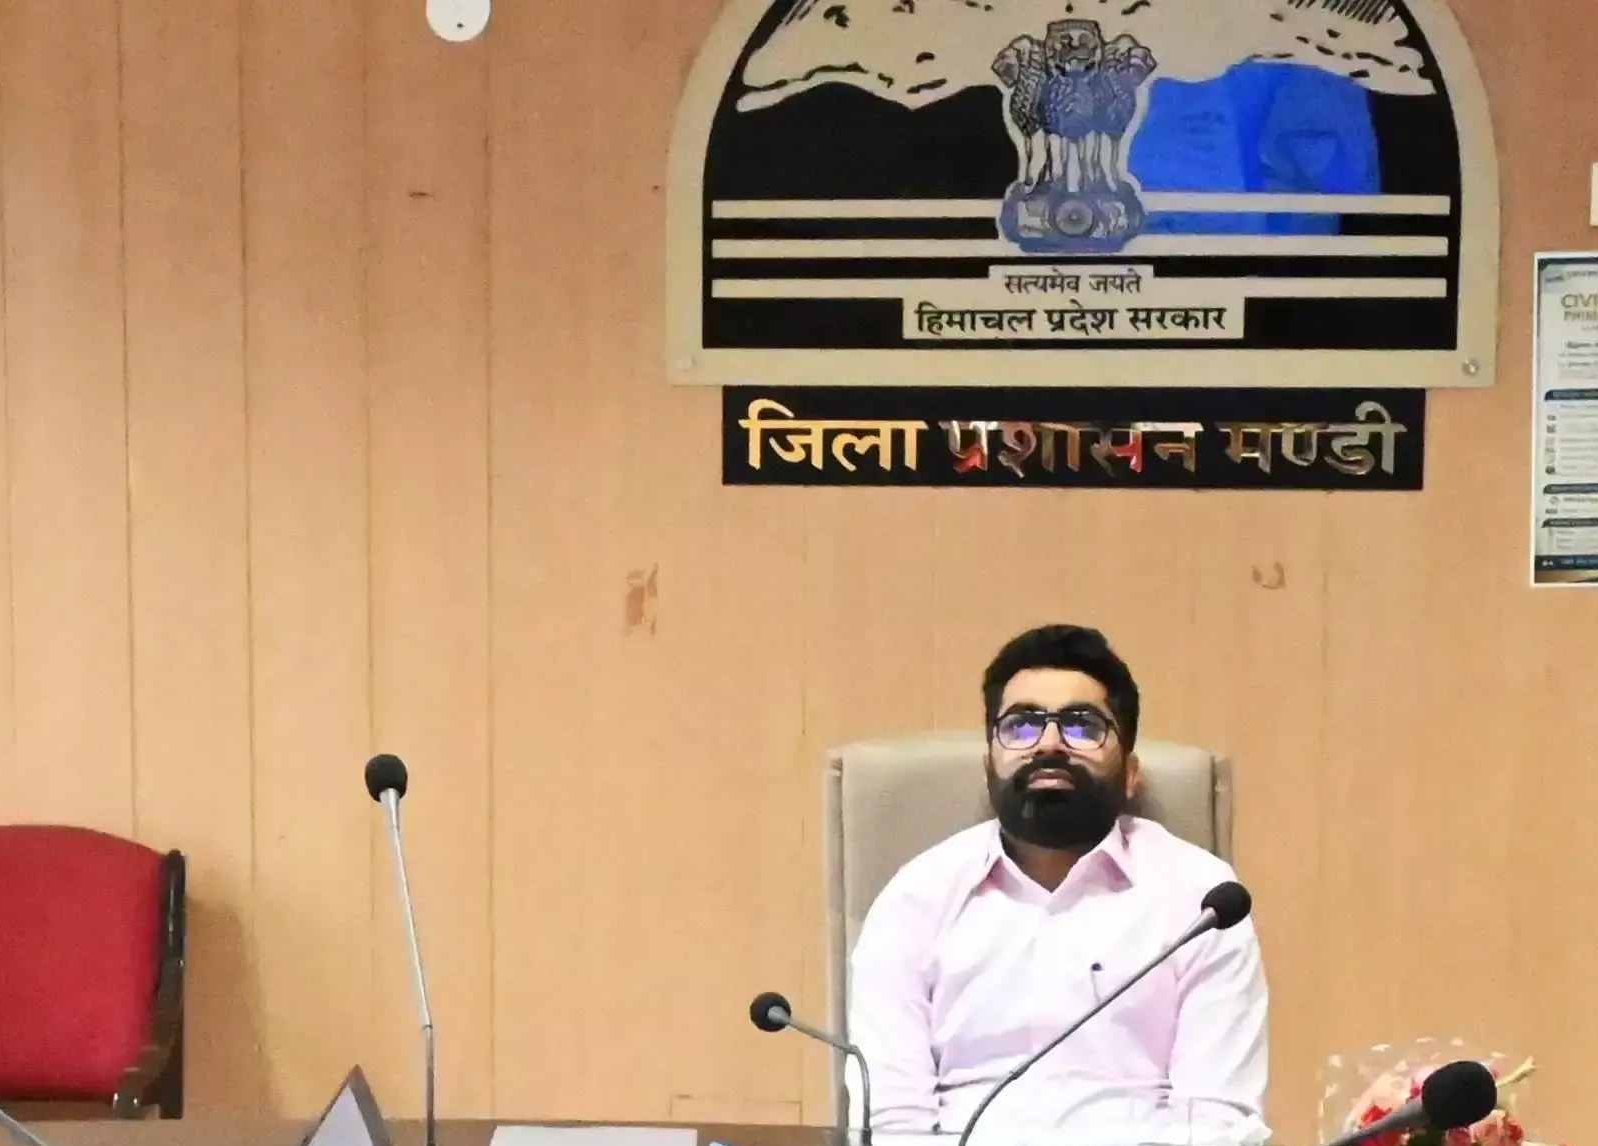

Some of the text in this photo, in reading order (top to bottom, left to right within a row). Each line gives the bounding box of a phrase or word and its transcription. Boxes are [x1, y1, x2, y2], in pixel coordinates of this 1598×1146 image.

[1005, 268, 1141, 294] सत्यमेव जयते
[915, 299, 1227, 335] हिमाचल प्रदेश सरकार
[738, 399, 1407, 477] जिला प्रशासन मण्डी
